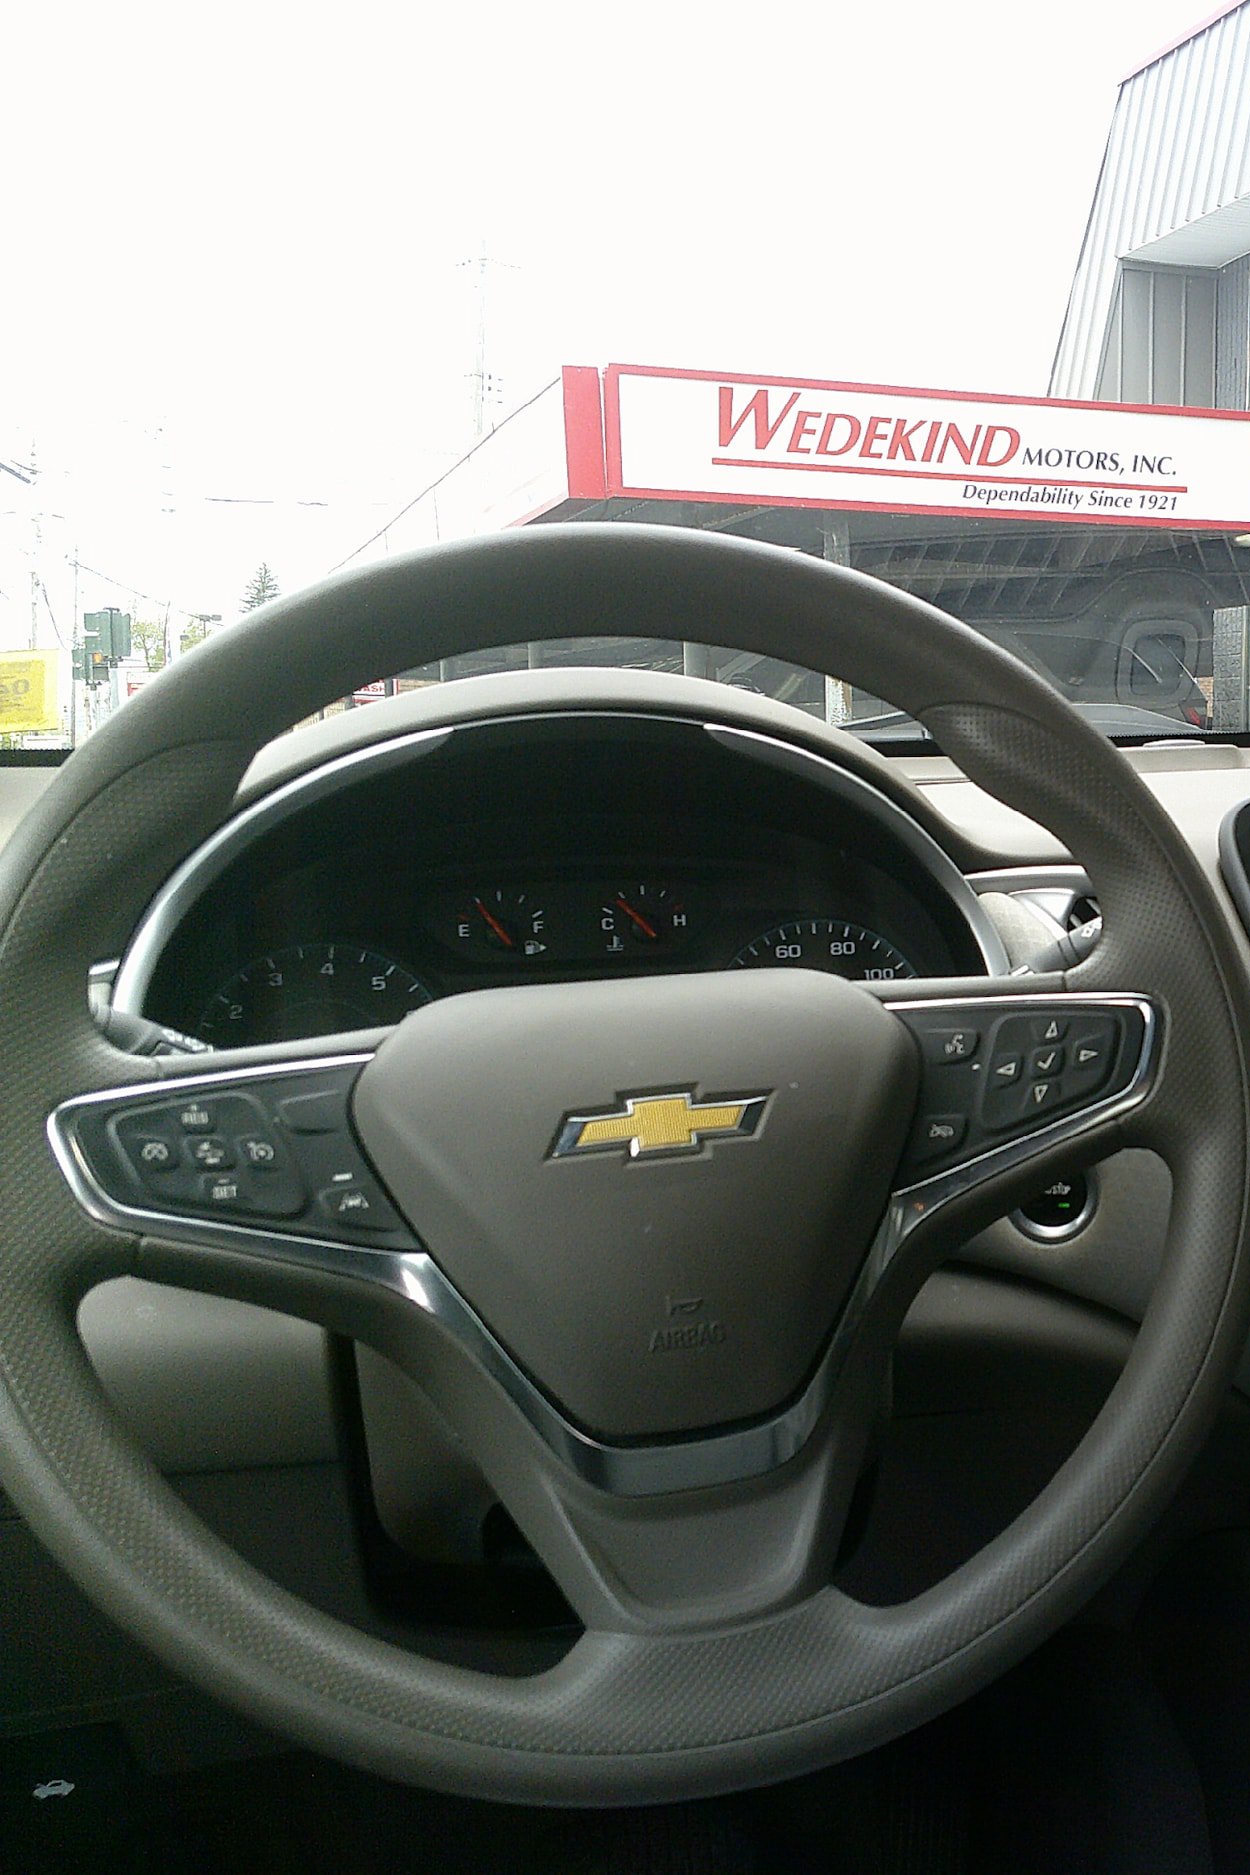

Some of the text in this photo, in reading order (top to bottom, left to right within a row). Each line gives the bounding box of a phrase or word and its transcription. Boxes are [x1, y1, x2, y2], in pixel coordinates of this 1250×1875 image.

[717, 386, 1178, 476] WEDEKIND MOTORS, INC.
[962, 484, 1178, 511] Dependability Since 1921
[533, 920, 543, 933] F
[601, 917, 614, 931] C
[673, 914, 687, 927] H
[458, 924, 470, 937] E
[775, 944, 801, 959] 60
[830, 941, 856, 956] 80
[320, 962, 334, 976] 4
[864, 968, 894, 980] 100
[268, 972, 284, 987] 3
[371, 975, 386, 991] 5
[230, 1004, 243, 1020] 2
